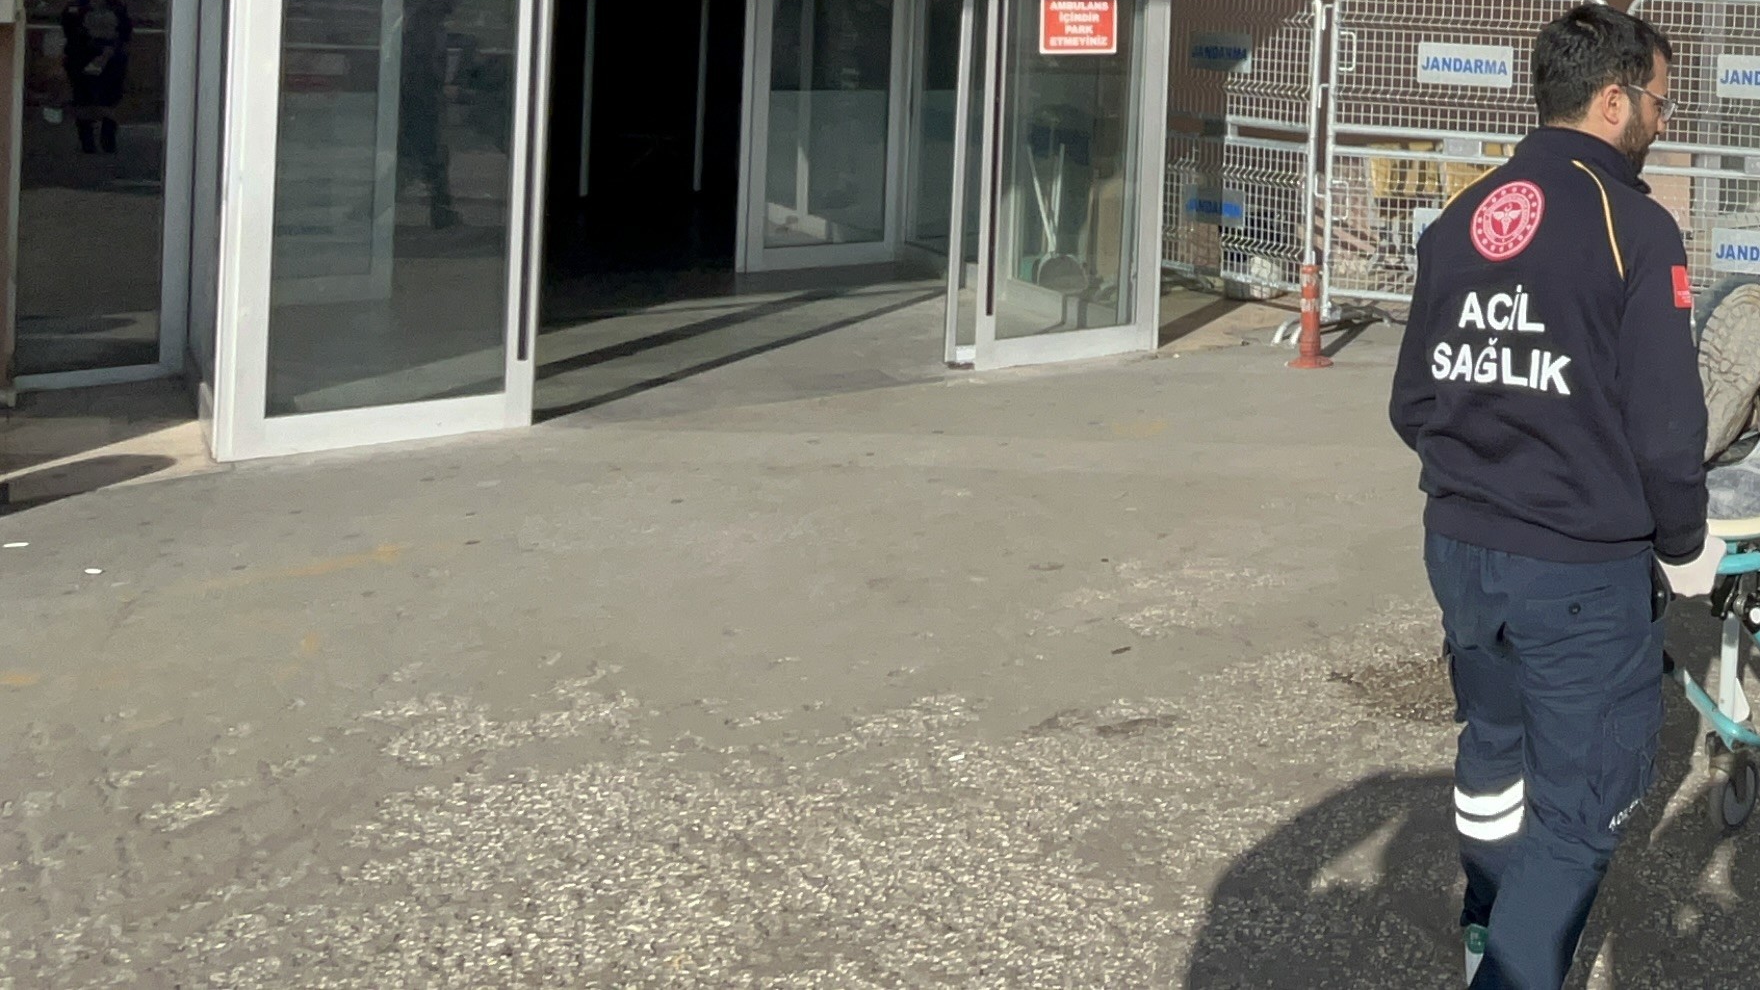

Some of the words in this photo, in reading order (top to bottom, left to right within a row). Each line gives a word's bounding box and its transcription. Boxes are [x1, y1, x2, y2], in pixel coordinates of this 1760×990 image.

[1064, 24, 1094, 35] PARK
[1422, 56, 1508, 76] JANDARMA
[1458, 284, 1546, 332] ACİL
[1431, 337, 1572, 395] SAĞLIK
